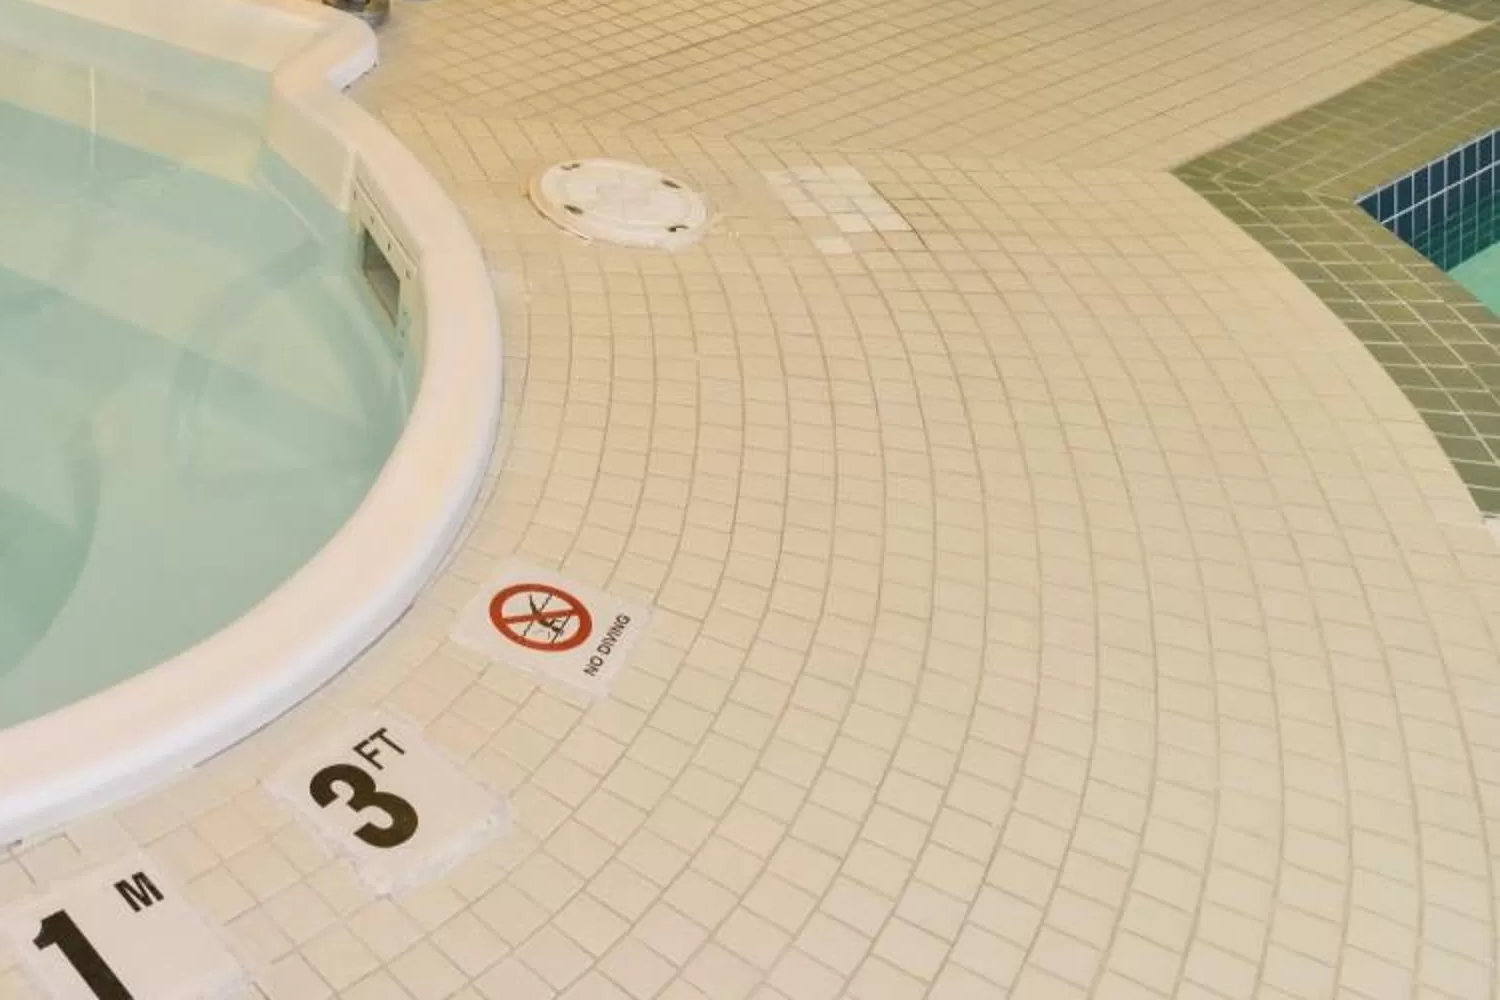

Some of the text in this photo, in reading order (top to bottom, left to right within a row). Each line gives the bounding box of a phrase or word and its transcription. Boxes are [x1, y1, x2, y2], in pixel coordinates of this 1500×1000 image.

[583, 613, 631, 677] NO DIVING
[309, 727, 418, 848] 3 FT
[32, 871, 164, 1000] 1 M
